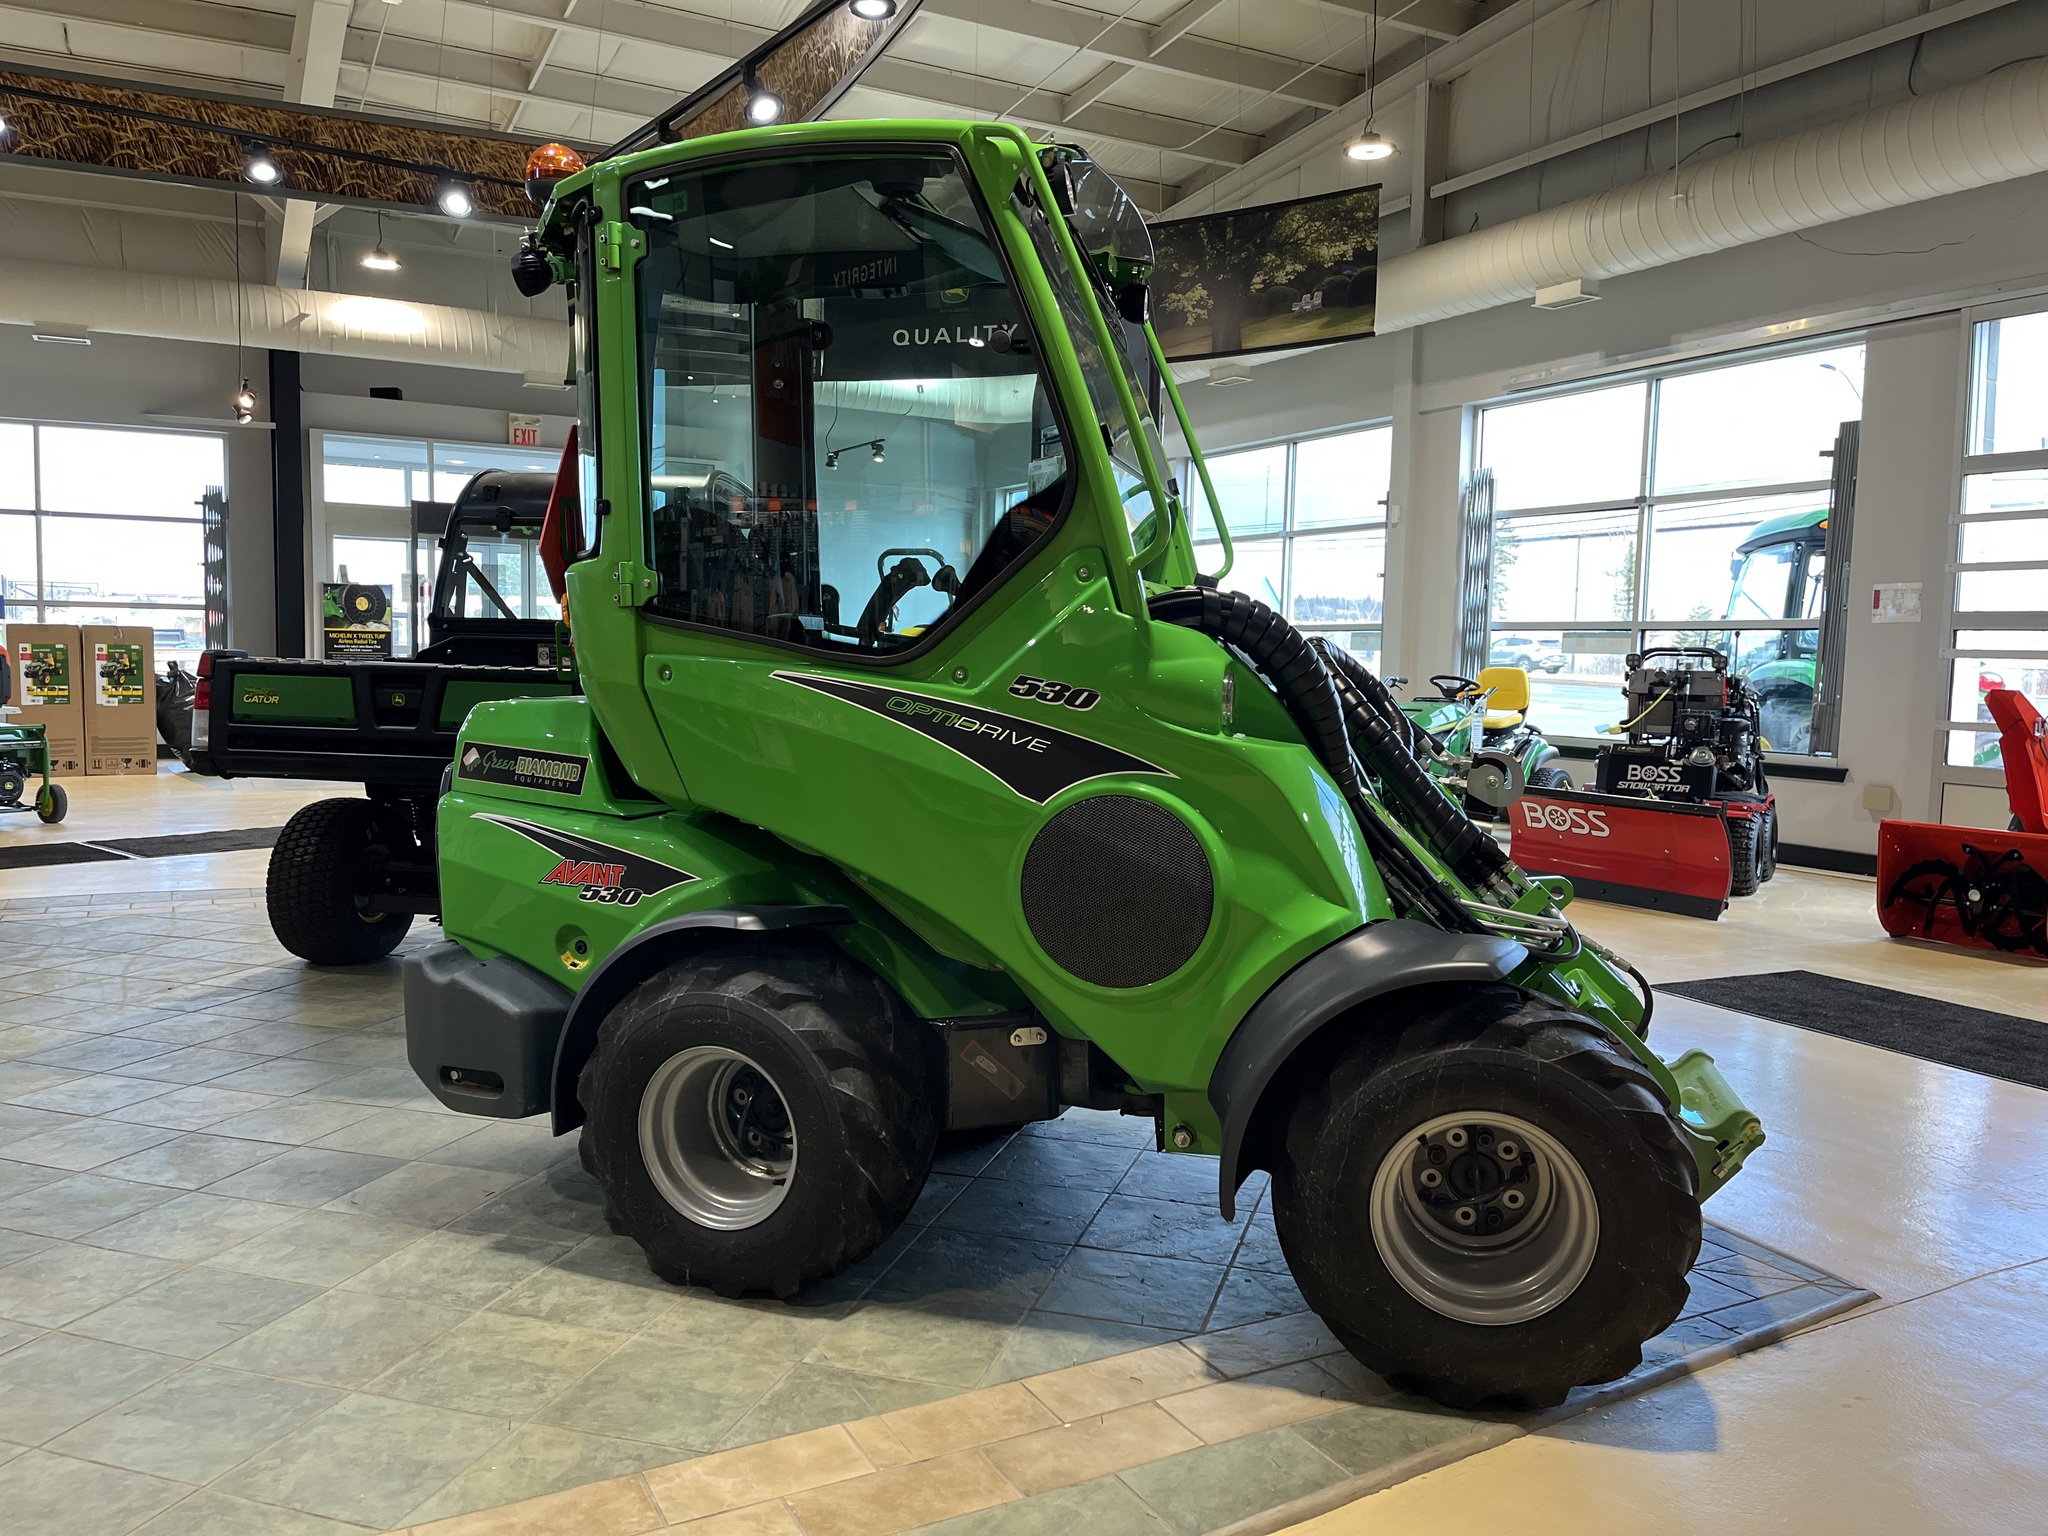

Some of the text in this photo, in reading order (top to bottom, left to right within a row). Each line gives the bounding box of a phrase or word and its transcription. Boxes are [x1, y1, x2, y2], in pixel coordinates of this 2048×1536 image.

[892, 323, 1018, 346] QUALITY
[513, 428, 537, 446] EXIT
[243, 694, 280, 704] GATOR
[1008, 674, 1101, 711] 530
[885, 696, 1051, 753] OPTIDRIVE
[483, 750, 581, 781] Green DIAMOND
[1627, 764, 1682, 783] BOSS
[514, 774, 571, 788] EQUIPMENT
[1521, 801, 1610, 838] BOSS
[539, 859, 626, 887] AVANT
[578, 884, 644, 906] 530
